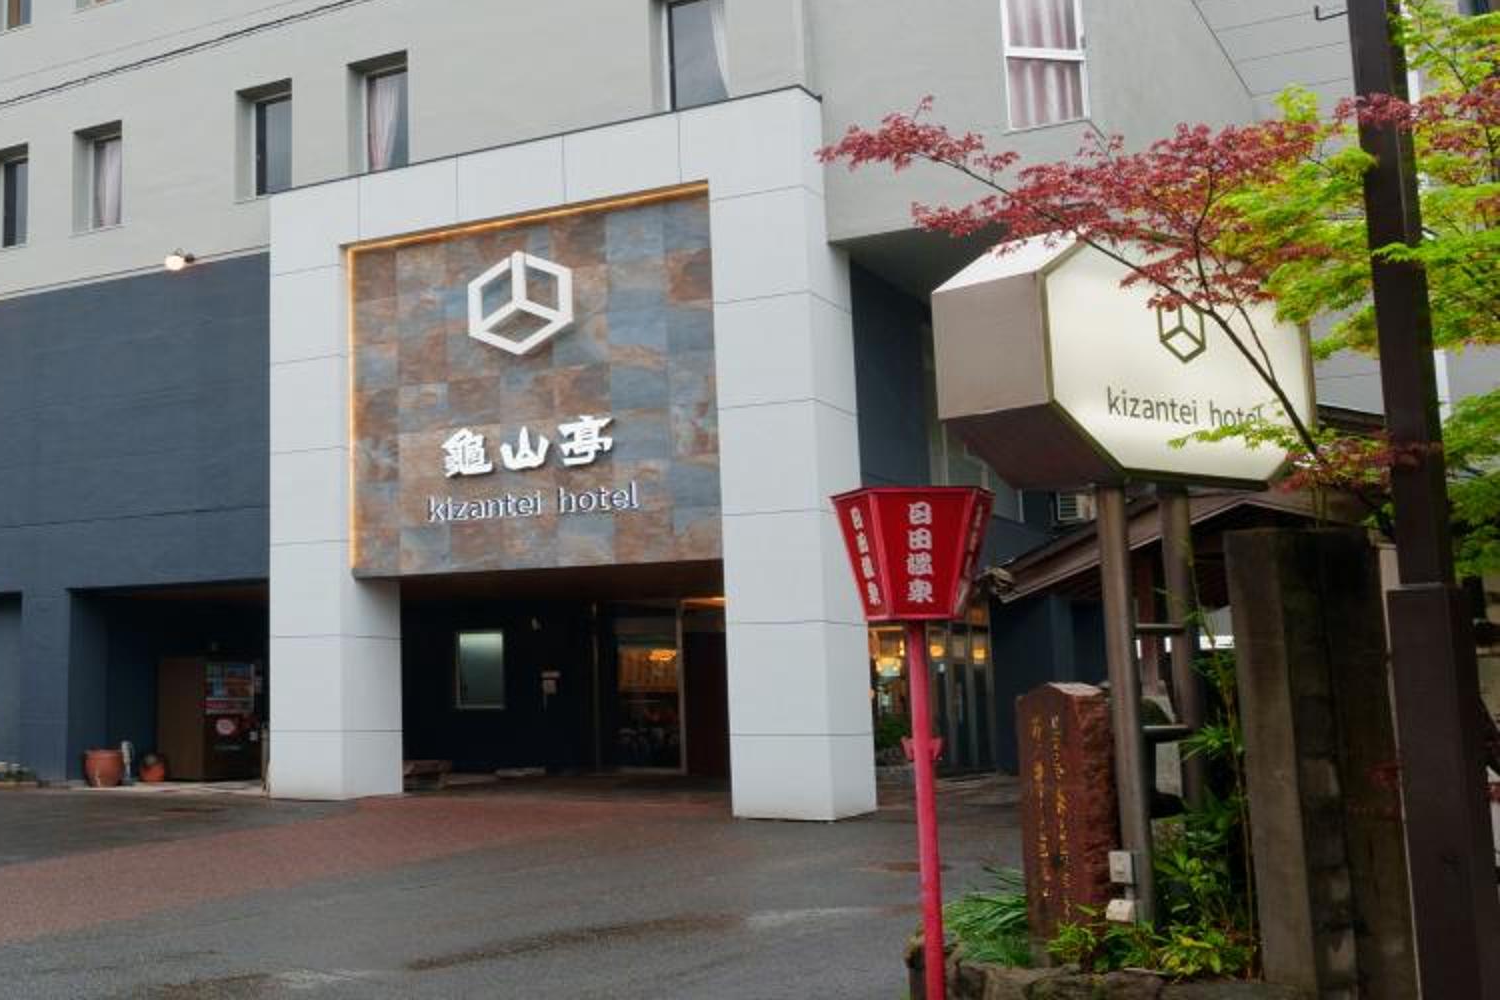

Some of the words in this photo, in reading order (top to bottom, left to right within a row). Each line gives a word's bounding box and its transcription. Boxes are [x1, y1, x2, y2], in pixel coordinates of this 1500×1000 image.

[1106, 386, 1200, 425] kizantei
[427, 489, 542, 523] kizantei
[557, 479, 640, 514] hotel
